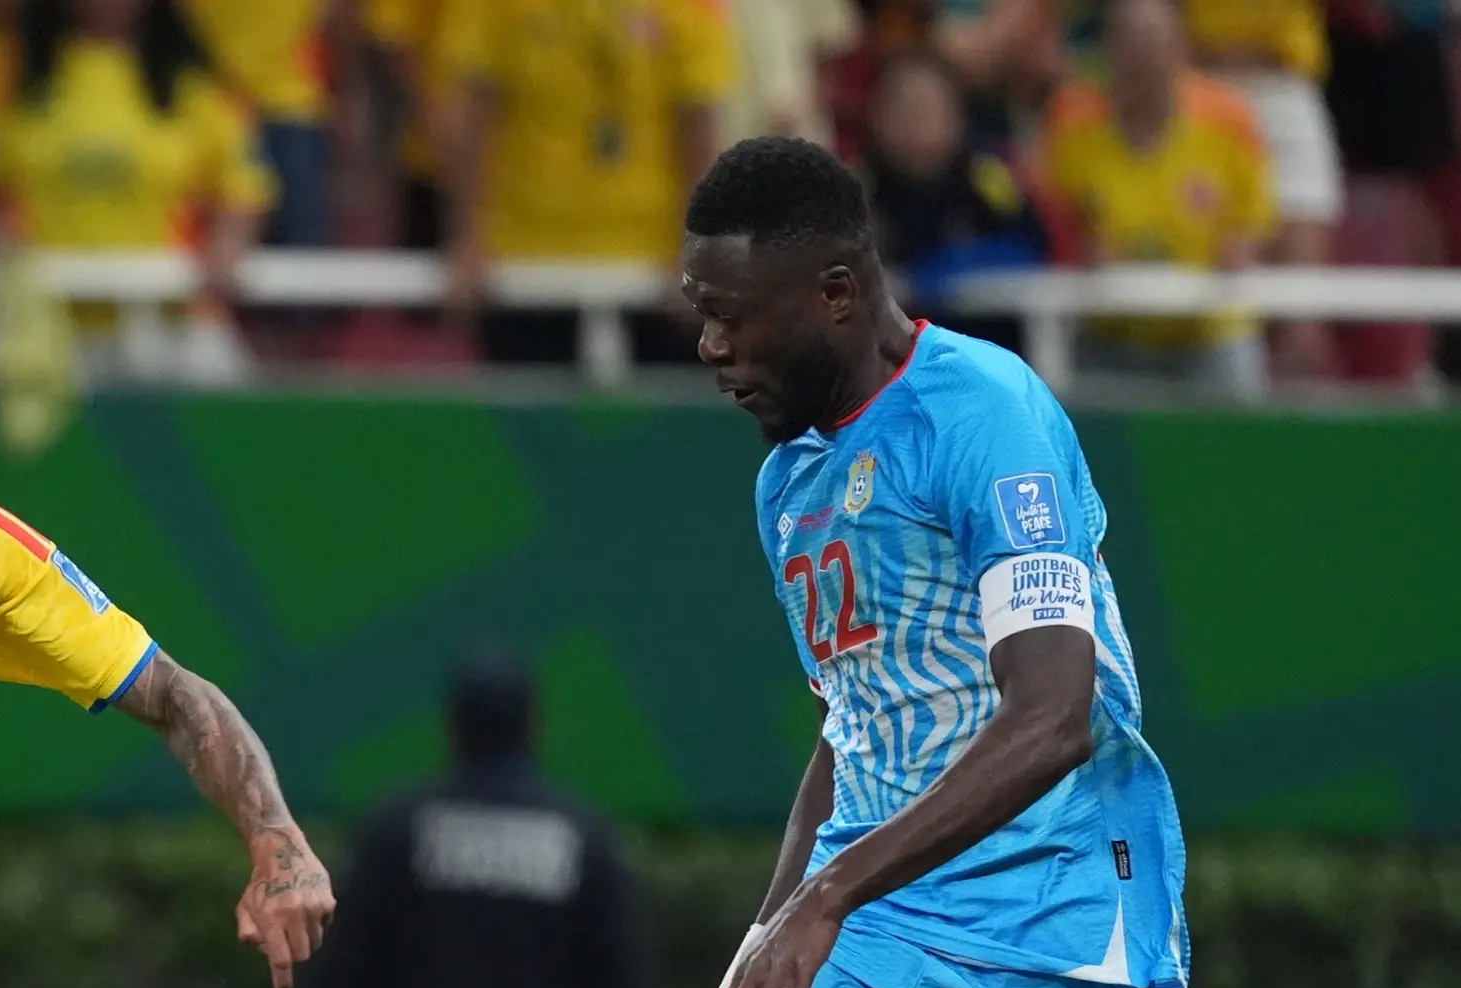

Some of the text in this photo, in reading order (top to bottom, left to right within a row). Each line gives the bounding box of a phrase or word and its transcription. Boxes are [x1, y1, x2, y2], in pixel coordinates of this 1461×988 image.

[1021, 515, 1053, 535] PEACE
[1012, 559, 1081, 577] FOOTBALL
[1013, 571, 1082, 592] UNITES
[784, 538, 879, 664] 22
[1007, 589, 1086, 611] the World
[1034, 608, 1064, 619] FIFA
